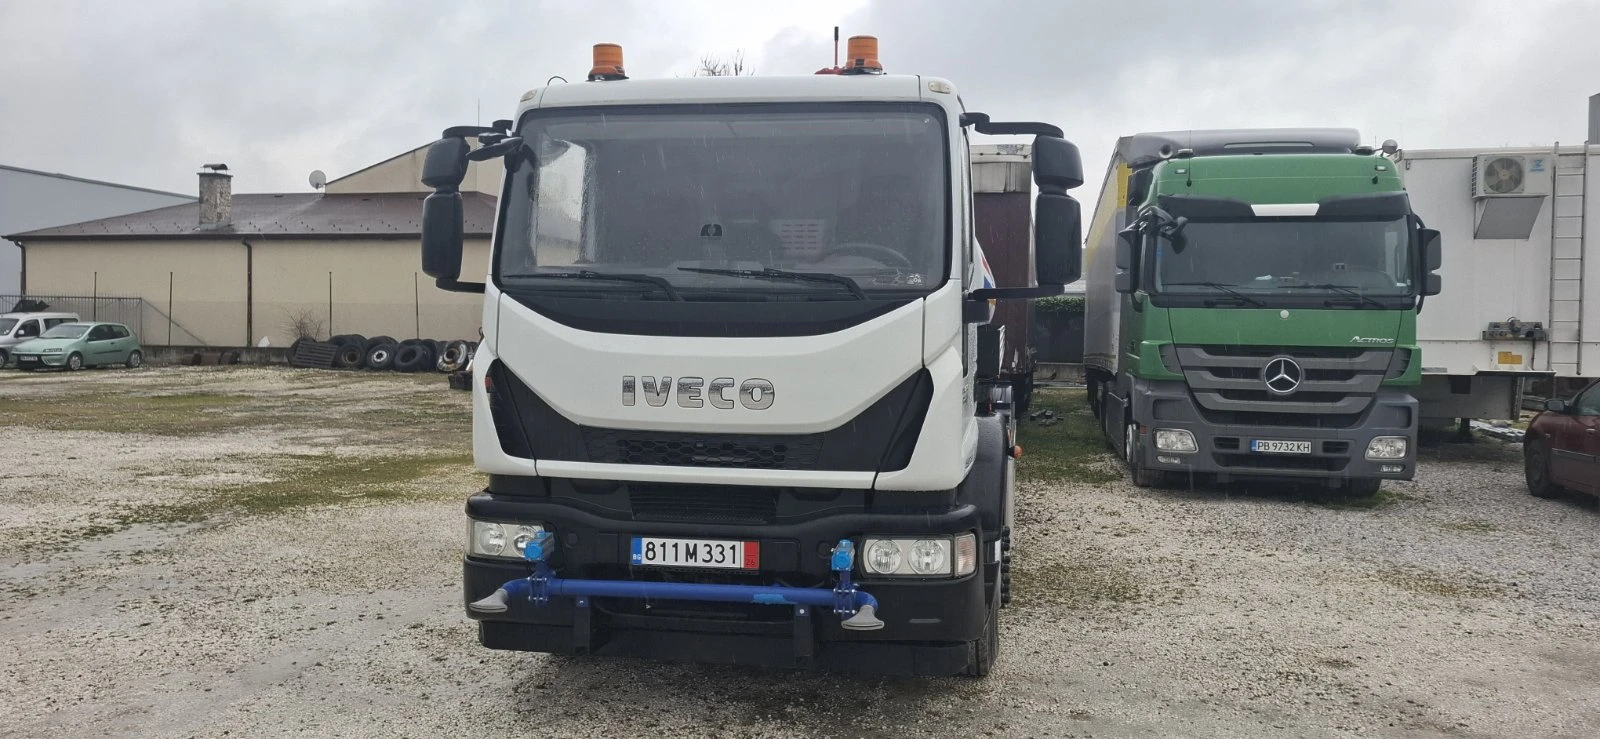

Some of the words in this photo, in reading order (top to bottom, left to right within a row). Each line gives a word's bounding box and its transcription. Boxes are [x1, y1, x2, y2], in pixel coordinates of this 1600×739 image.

[622, 375, 775, 410] IVECO
[1257, 441, 1270, 451] PB
[1272, 442, 1295, 452] 9732
